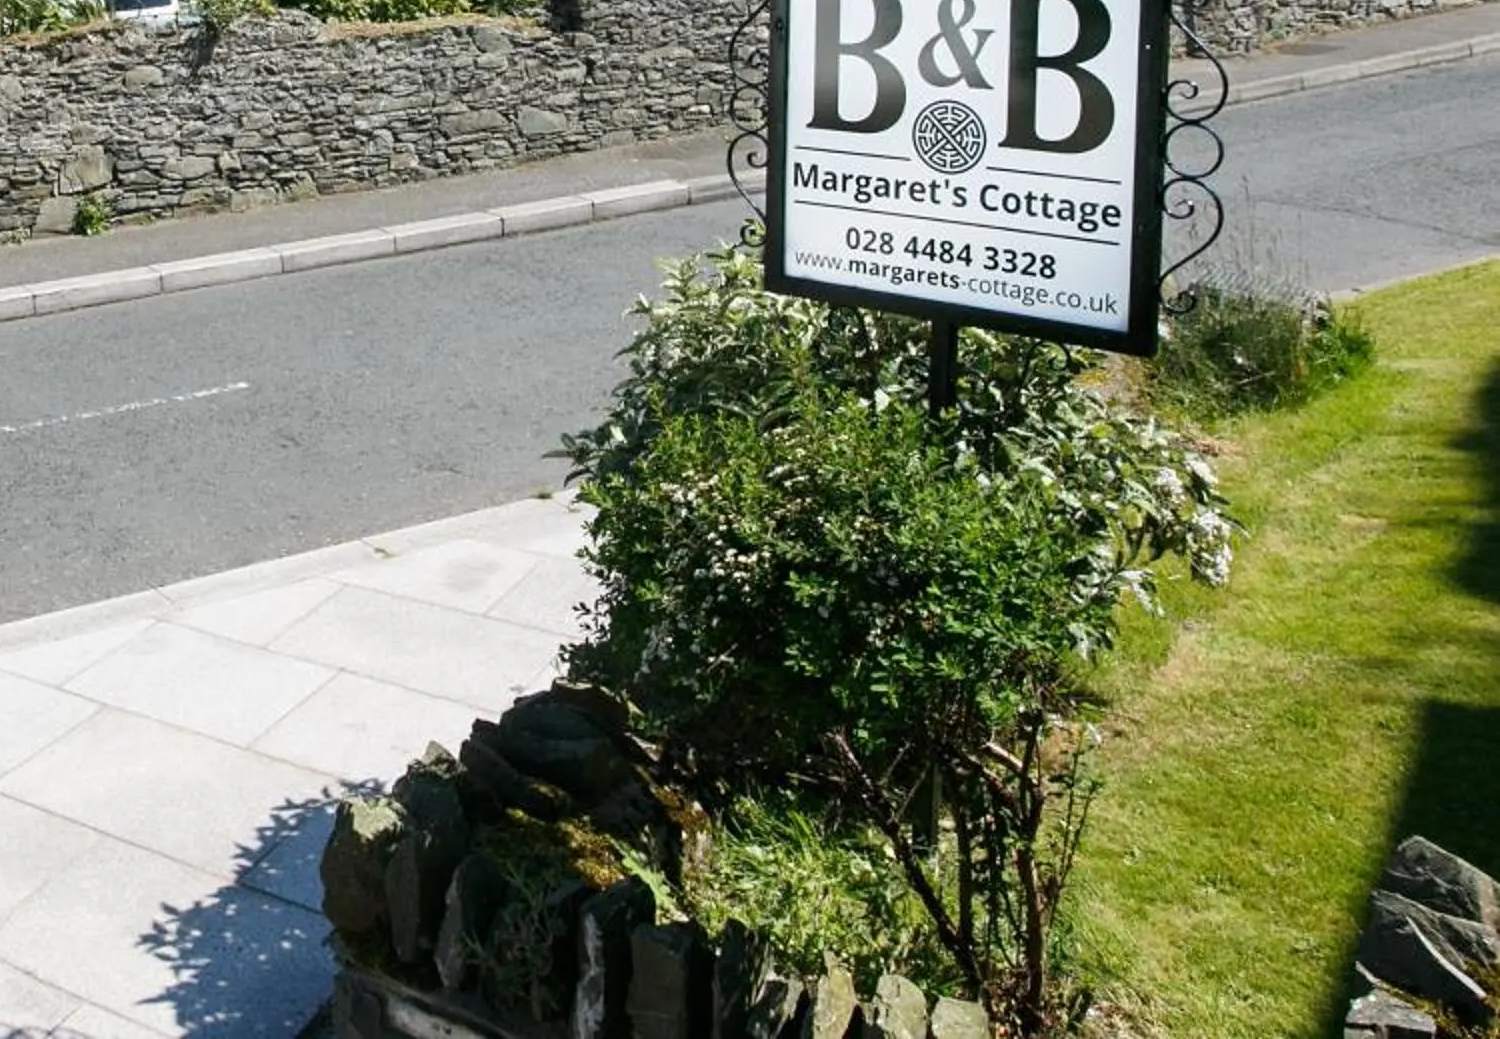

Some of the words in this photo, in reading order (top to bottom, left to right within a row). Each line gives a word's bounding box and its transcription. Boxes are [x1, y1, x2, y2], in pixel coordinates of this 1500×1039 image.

[793, 162, 968, 208] Margaret's
[980, 184, 1122, 232] Cottage
[795, 249, 1118, 315] www.margarets-cottage.co.uk
[846, 227, 894, 255] 028
[903, 236, 973, 267] 4484
[983, 246, 1057, 279] 3328
